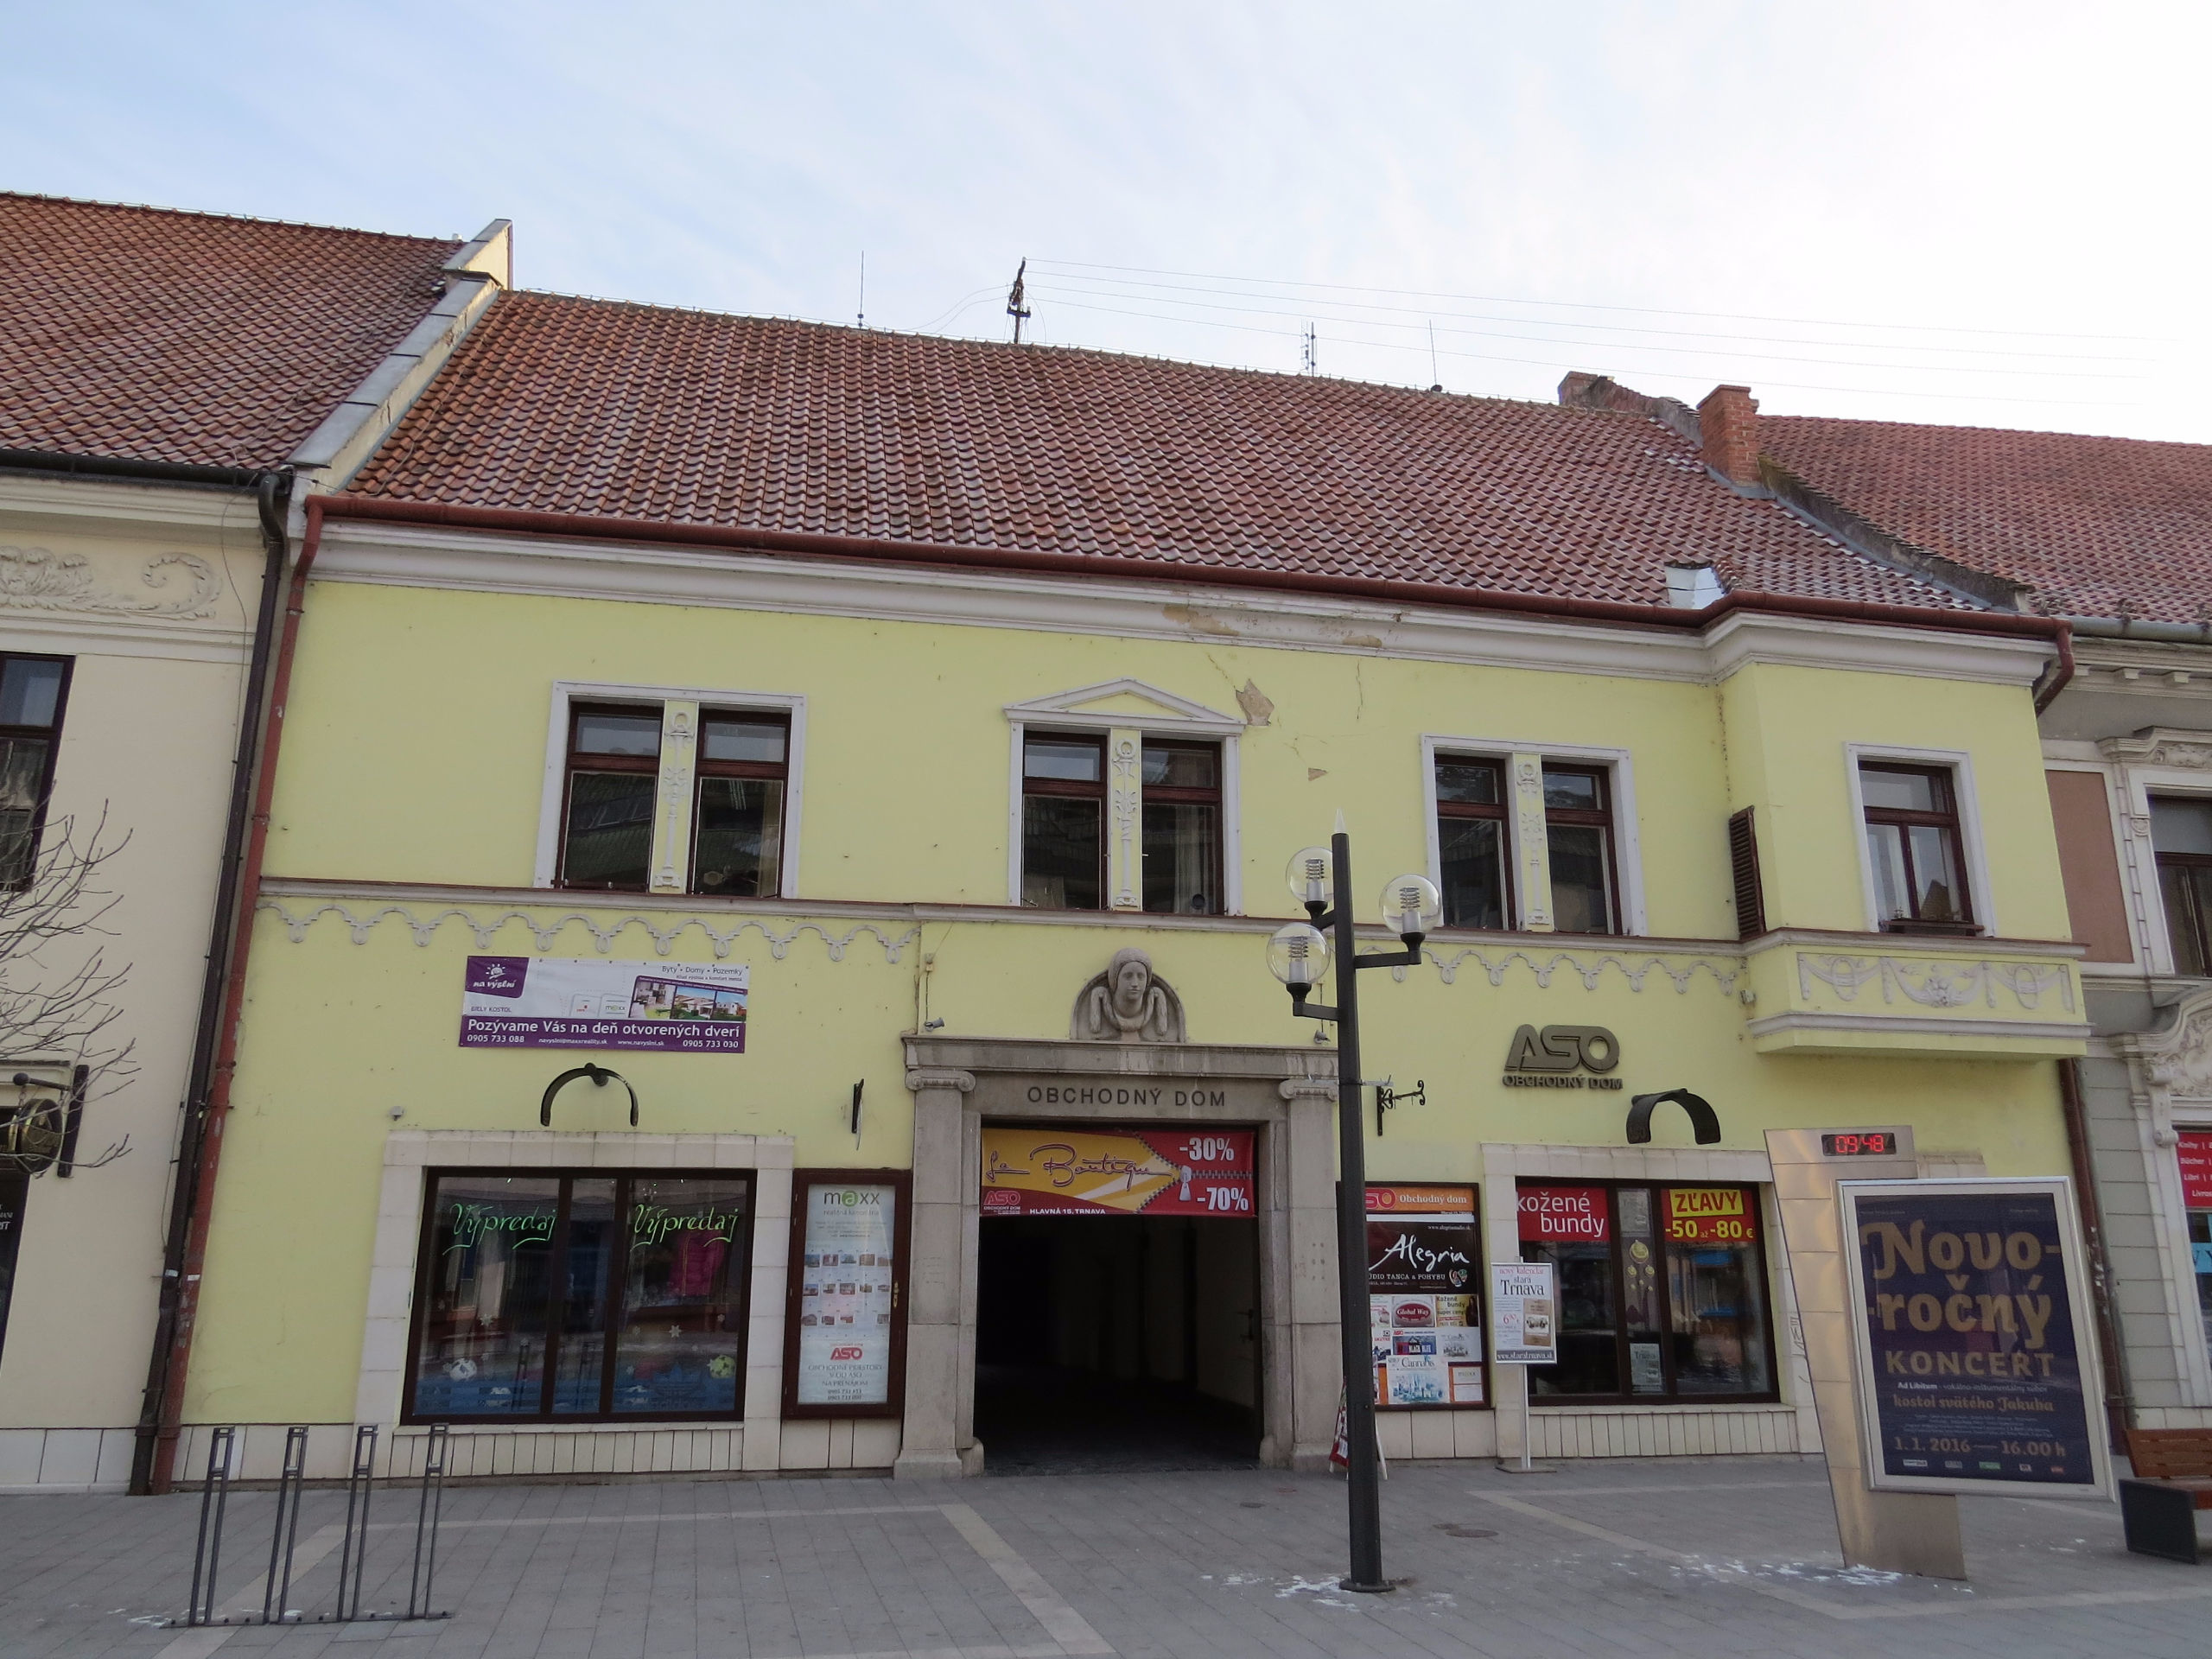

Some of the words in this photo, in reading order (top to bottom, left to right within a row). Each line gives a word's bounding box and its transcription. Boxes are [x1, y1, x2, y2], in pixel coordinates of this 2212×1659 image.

[487, 979, 517, 988] výslní
[467, 1019, 538, 1033] Pozývame
[543, 1020, 566, 1033] Vás
[570, 1024, 588, 1033] na
[592, 1022, 618, 1034] deň
[623, 1023, 700, 1038] otvorených
[705, 1025, 740, 1037] dverí
[492, 1034, 506, 1043] 733
[1504, 1024, 1619, 1074] ASO
[1502, 1074, 1586, 1089] OBCHODNÝ
[1588, 1077, 1623, 1090] DOM
[1027, 1086, 1162, 1106] OBCHODNÝ
[1174, 1090, 1225, 1107] DOM
[1179, 1137, 1235, 1161] -30%
[1030, 1142, 1173, 1192] Boutique
[823, 1190, 880, 1207] maxx
[983, 1190, 1020, 1205] ASO
[1197, 1187, 1249, 1211] -70%
[1400, 1194, 1445, 1205] Obchodný
[1446, 1195, 1467, 1204] dom
[1516, 1192, 1591, 1211] kožené
[1675, 1192, 1738, 1212] ZĽAVY
[442, 1203, 557, 1256] Výpredaj
[629, 1204, 739, 1252] Výpredaj
[1541, 1213, 1605, 1237] bundy
[1665, 1220, 1698, 1238] -50
[1710, 1220, 1742, 1238] -80
[1746, 1228, 1754, 1238] €
[1369, 1234, 1470, 1272] Alegria
[1859, 1218, 2061, 1280] Novo-
[1500, 1279, 1544, 1295] Trnava
[1513, 1274, 1531, 1284] stará
[1868, 1274, 2051, 1350] -ročný
[830, 1347, 862, 1360] ASO
[1885, 1350, 2055, 1377] KONCERT
[1893, 1394, 1936, 1408] kostol
[1939, 1395, 1994, 1409] svätého
[1997, 1397, 2055, 1413] Jakuba
[1894, 1437, 1908, 1451] 1.
[1911, 1438, 1926, 1452] 1.
[1929, 1438, 1971, 1452] 2016
[2001, 1440, 2051, 1457] 16.00
[2056, 1441, 2066, 1457] h
